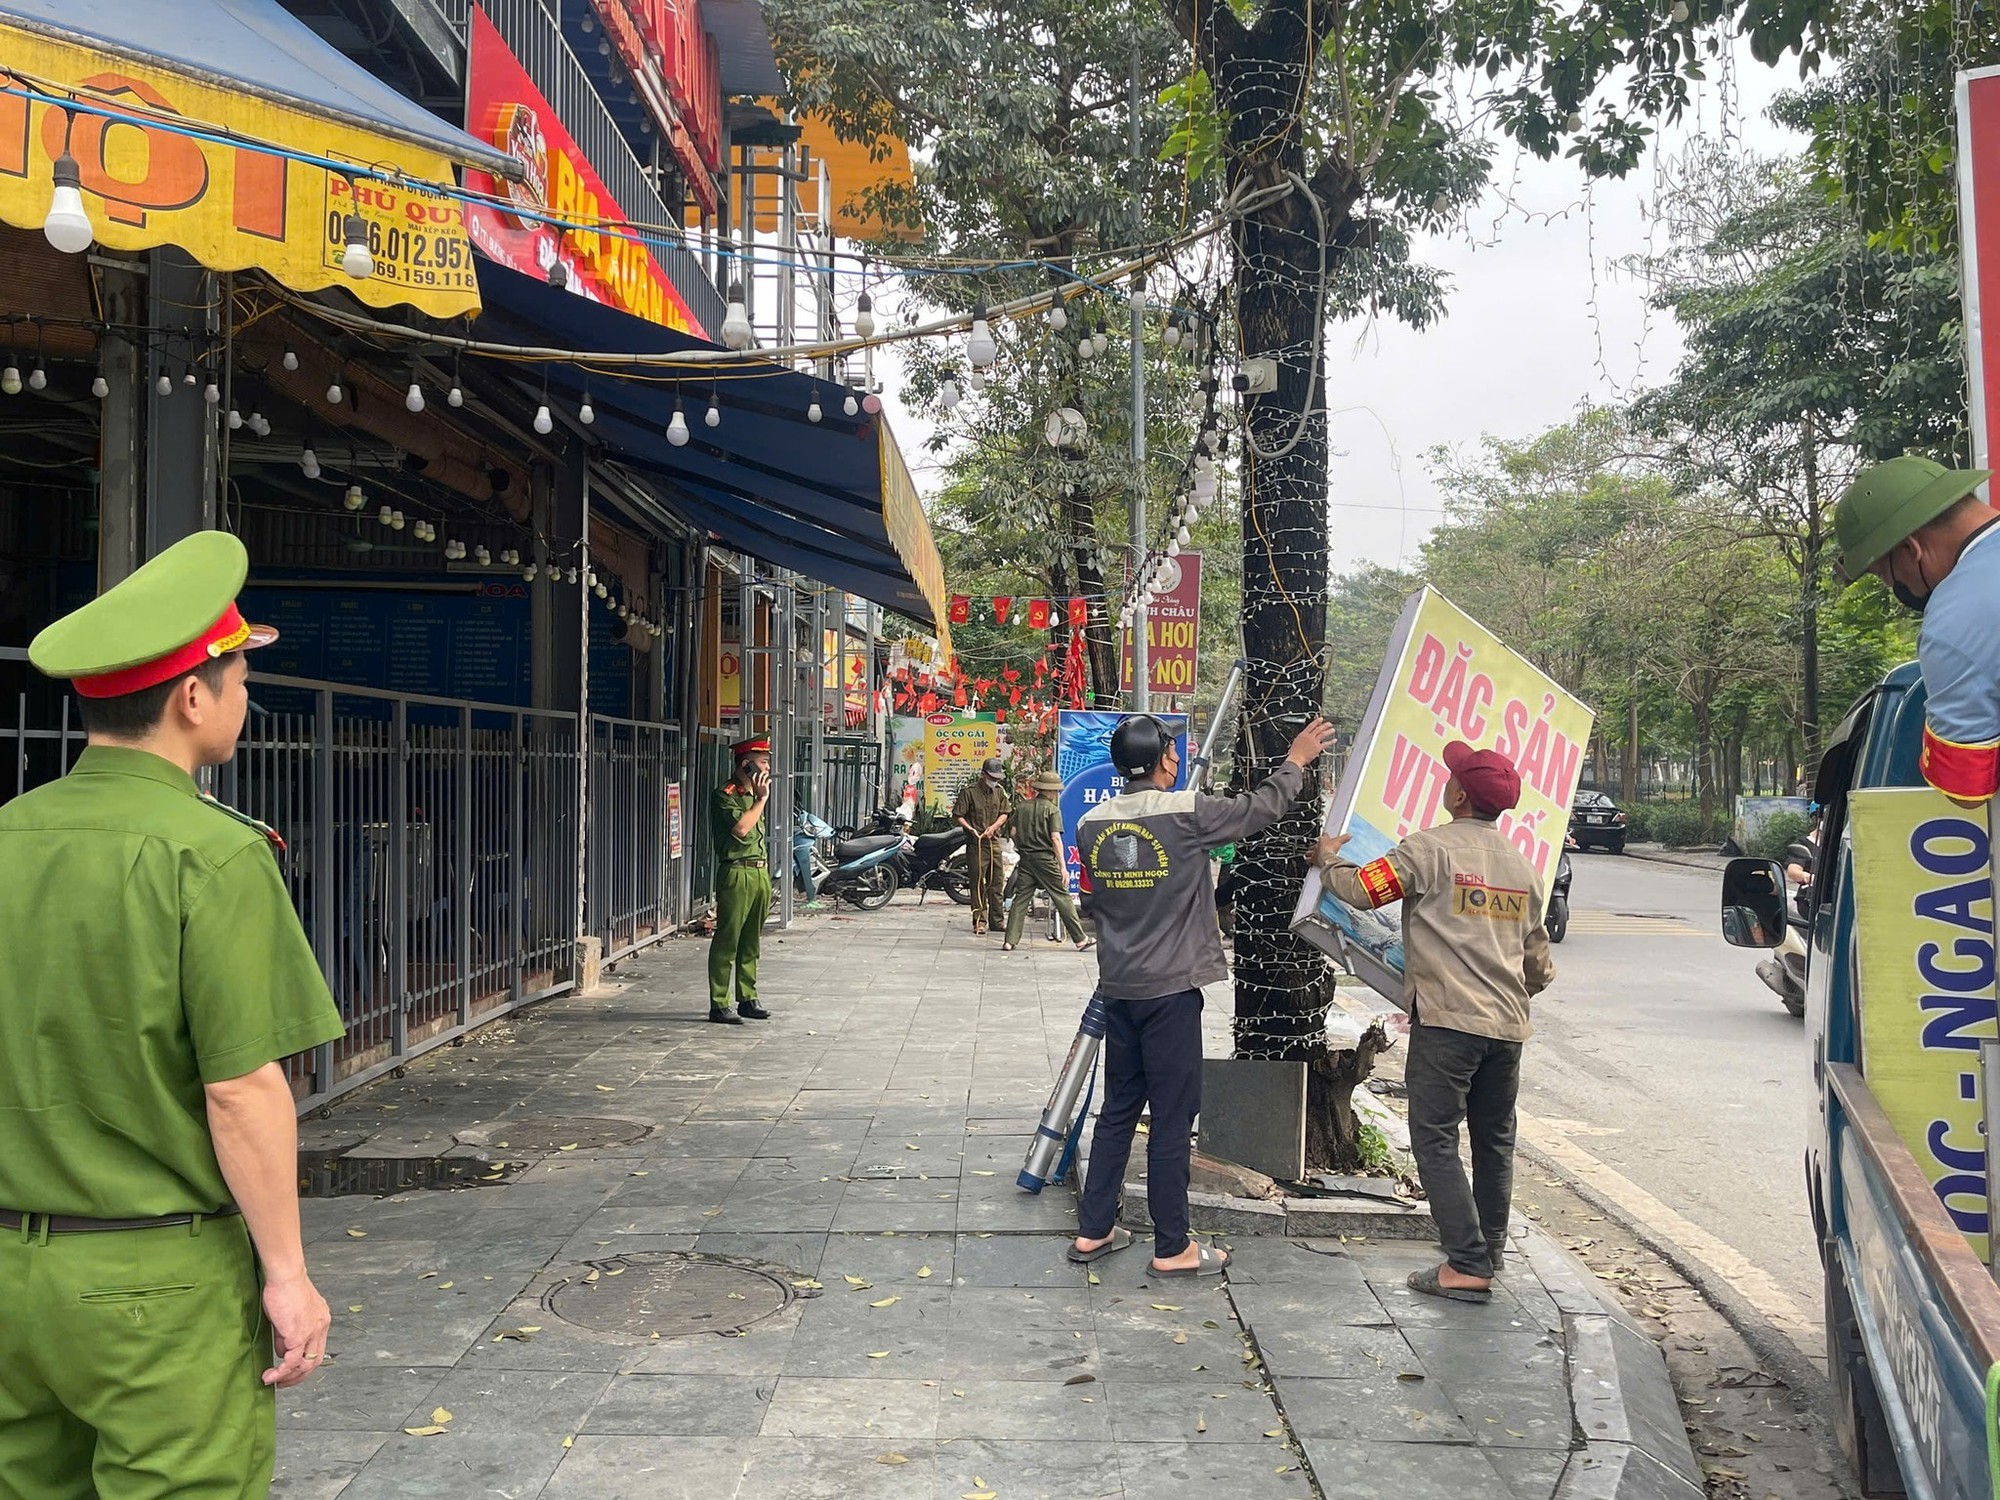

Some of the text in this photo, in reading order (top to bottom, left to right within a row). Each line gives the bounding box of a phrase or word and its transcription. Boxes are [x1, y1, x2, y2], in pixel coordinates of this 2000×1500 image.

[330, 177, 397, 213] PHÚ
[556, 148, 600, 272] BIA
[329, 210, 472, 270] 06.012.957
[1160, 620, 1195, 649] HƠI
[1161, 605, 1195, 618] CHÂU
[1156, 653, 1193, 691] NỘI
[1408, 633, 1580, 810] ĐẶC SẢN
[1382, 734, 1451, 838] VỊT
[1145, 869, 1169, 879] NGỌC
[1909, 817, 1999, 1050] NGAO
